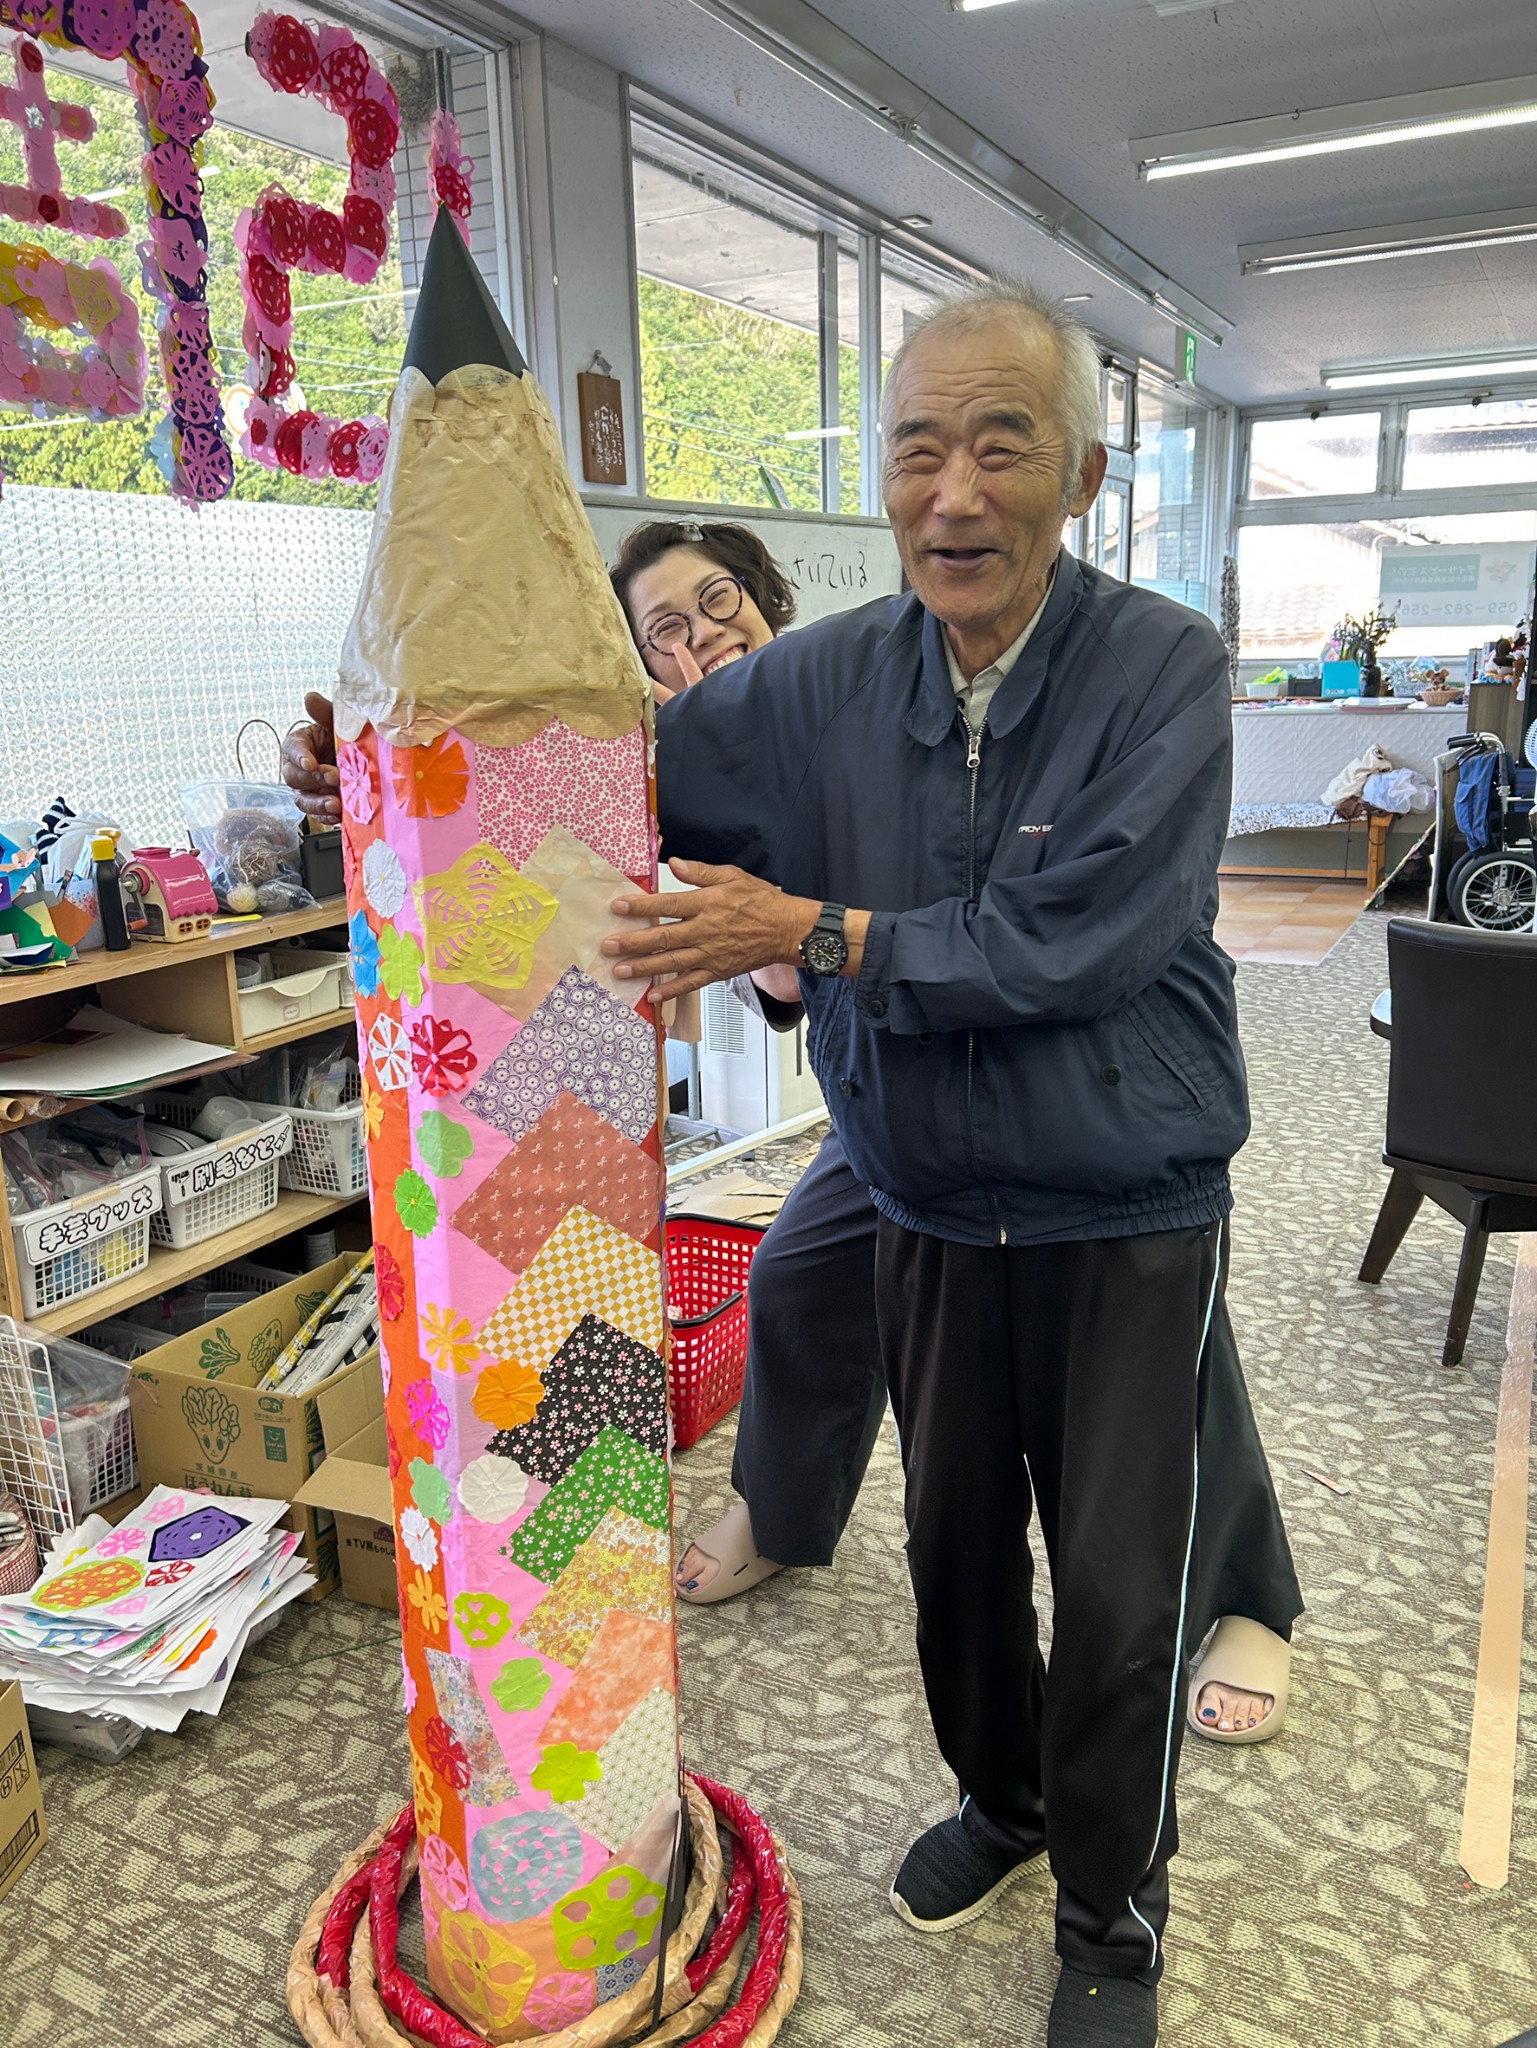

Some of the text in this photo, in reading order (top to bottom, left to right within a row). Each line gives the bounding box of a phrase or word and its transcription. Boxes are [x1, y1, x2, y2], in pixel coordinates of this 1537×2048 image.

[192, 1134, 276, 1193] 刷毛など
[39, 1184, 153, 1253] 手芸グッズ
